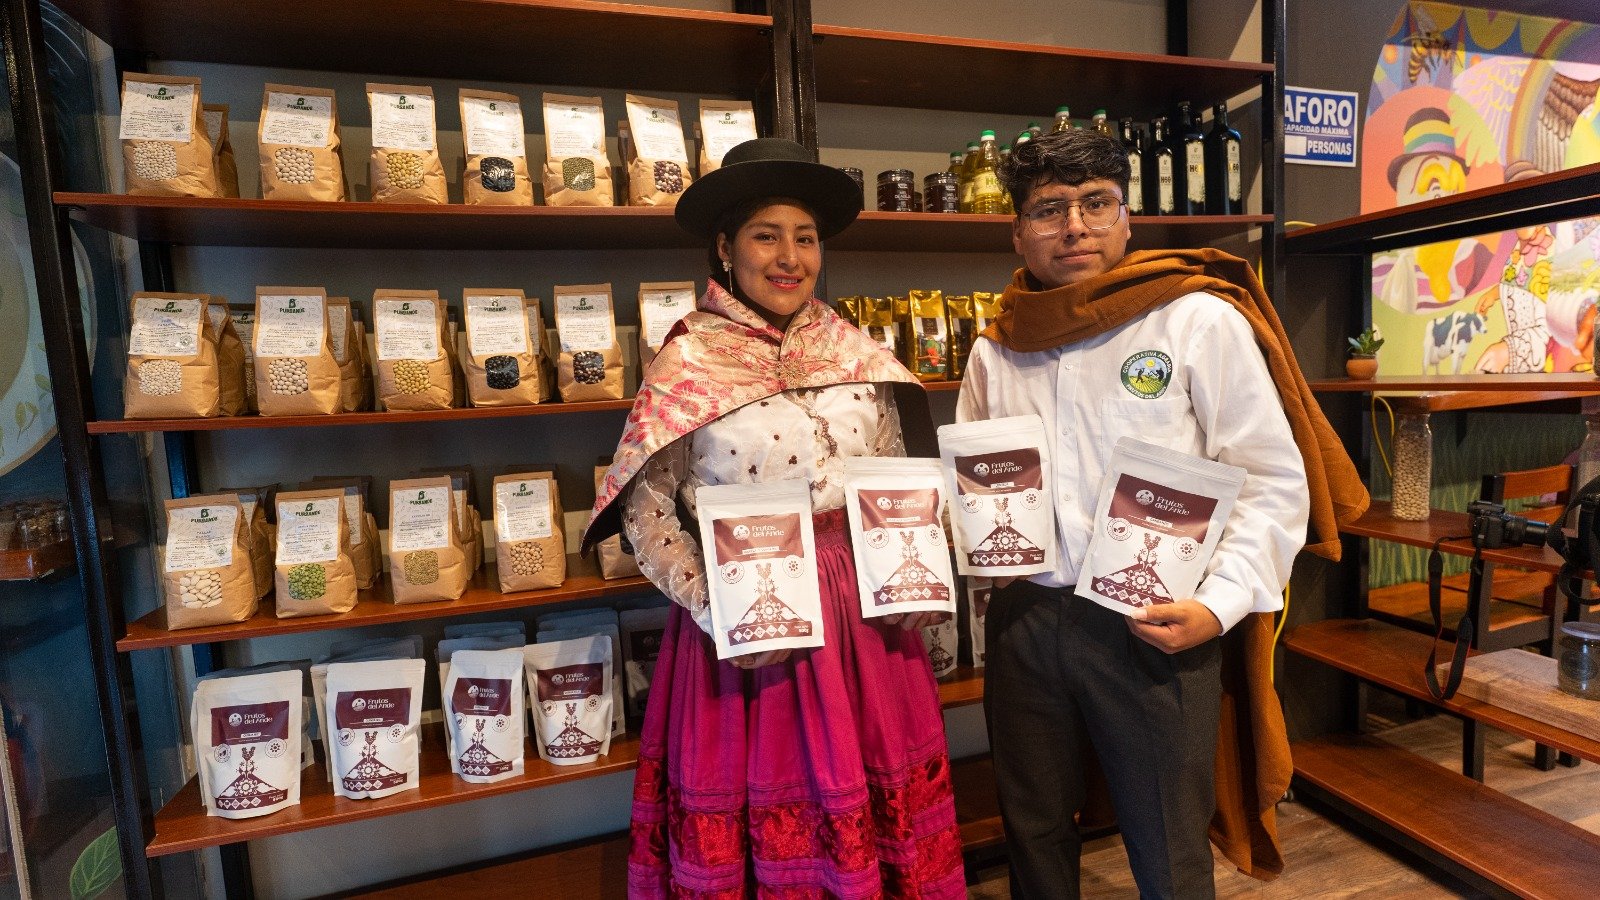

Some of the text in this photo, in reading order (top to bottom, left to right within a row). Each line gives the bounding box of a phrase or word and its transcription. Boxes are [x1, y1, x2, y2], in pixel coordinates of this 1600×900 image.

[1285, 94, 1353, 128] AFORO
[1284, 125, 1320, 135] APACIDAD
[1307, 139, 1352, 156] PERSONAS
[1122, 352, 1157, 374] COOPERATIVA
[1156, 496, 1184, 508] Frutos
[1154, 502, 1190, 516] del Ande
[244, 712, 266, 720] Frutos
[255, 716, 273, 724] Ande
